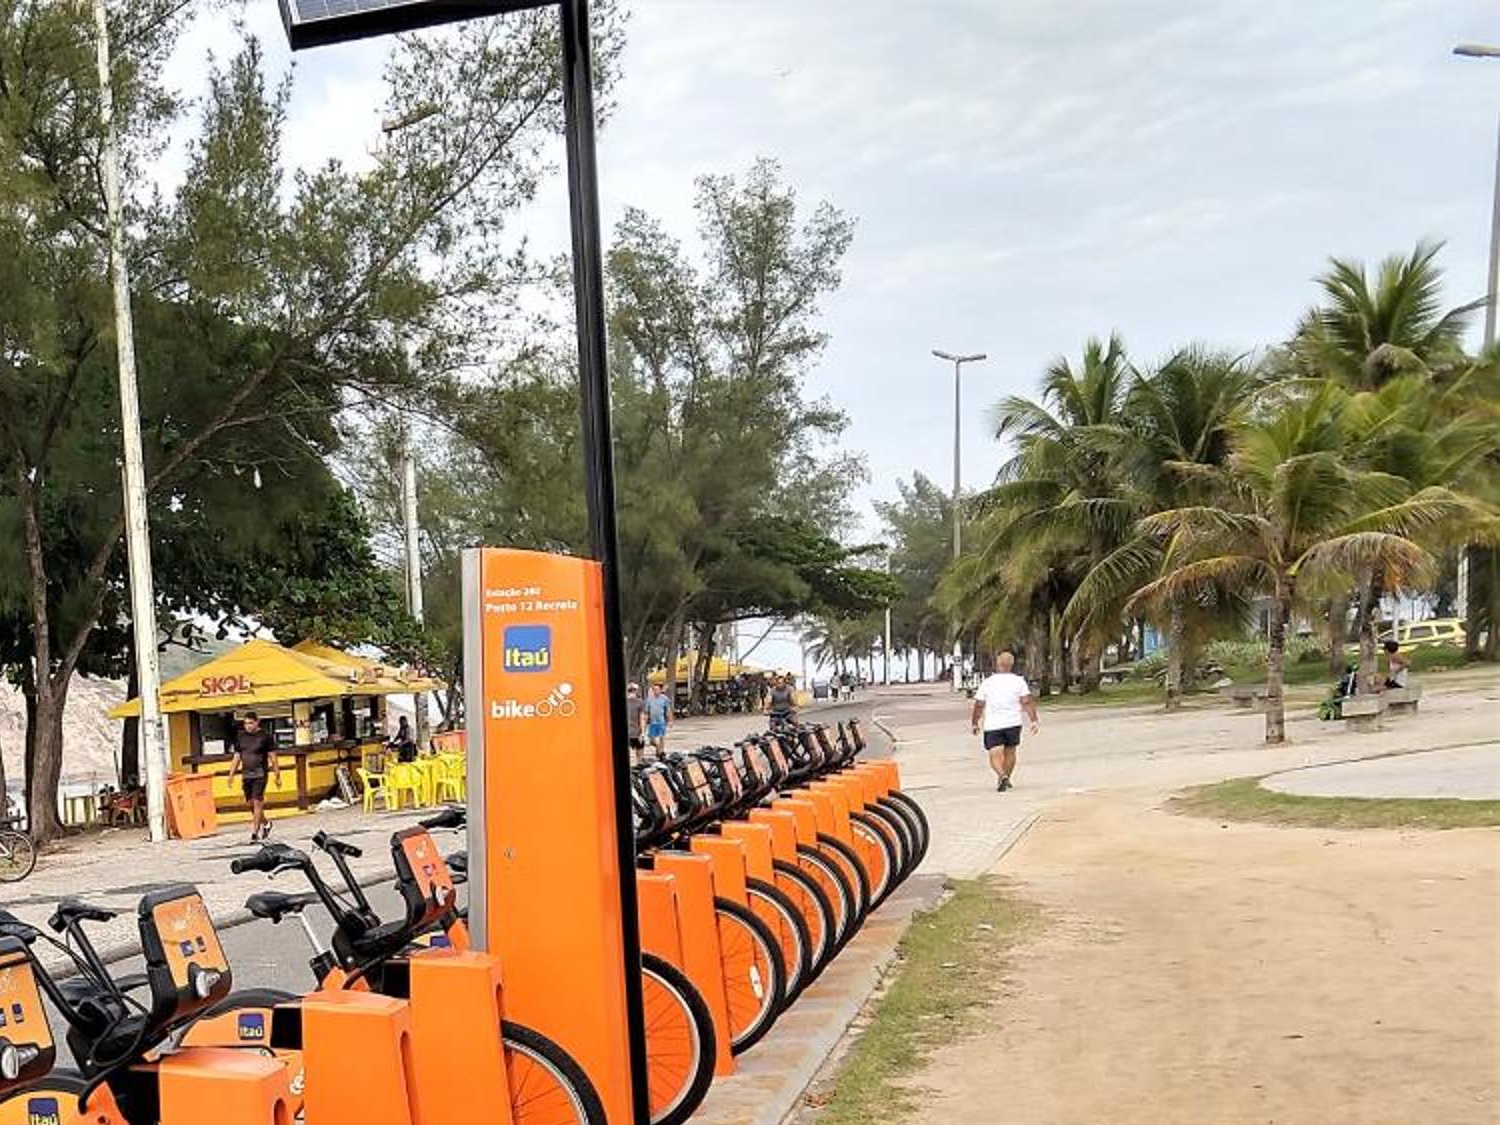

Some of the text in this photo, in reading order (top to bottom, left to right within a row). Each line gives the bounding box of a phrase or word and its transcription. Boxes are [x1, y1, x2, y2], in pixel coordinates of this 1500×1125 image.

[505, 647, 549, 668] Itaú
[201, 675, 250, 694] SKOL
[491, 701, 534, 718] bike
